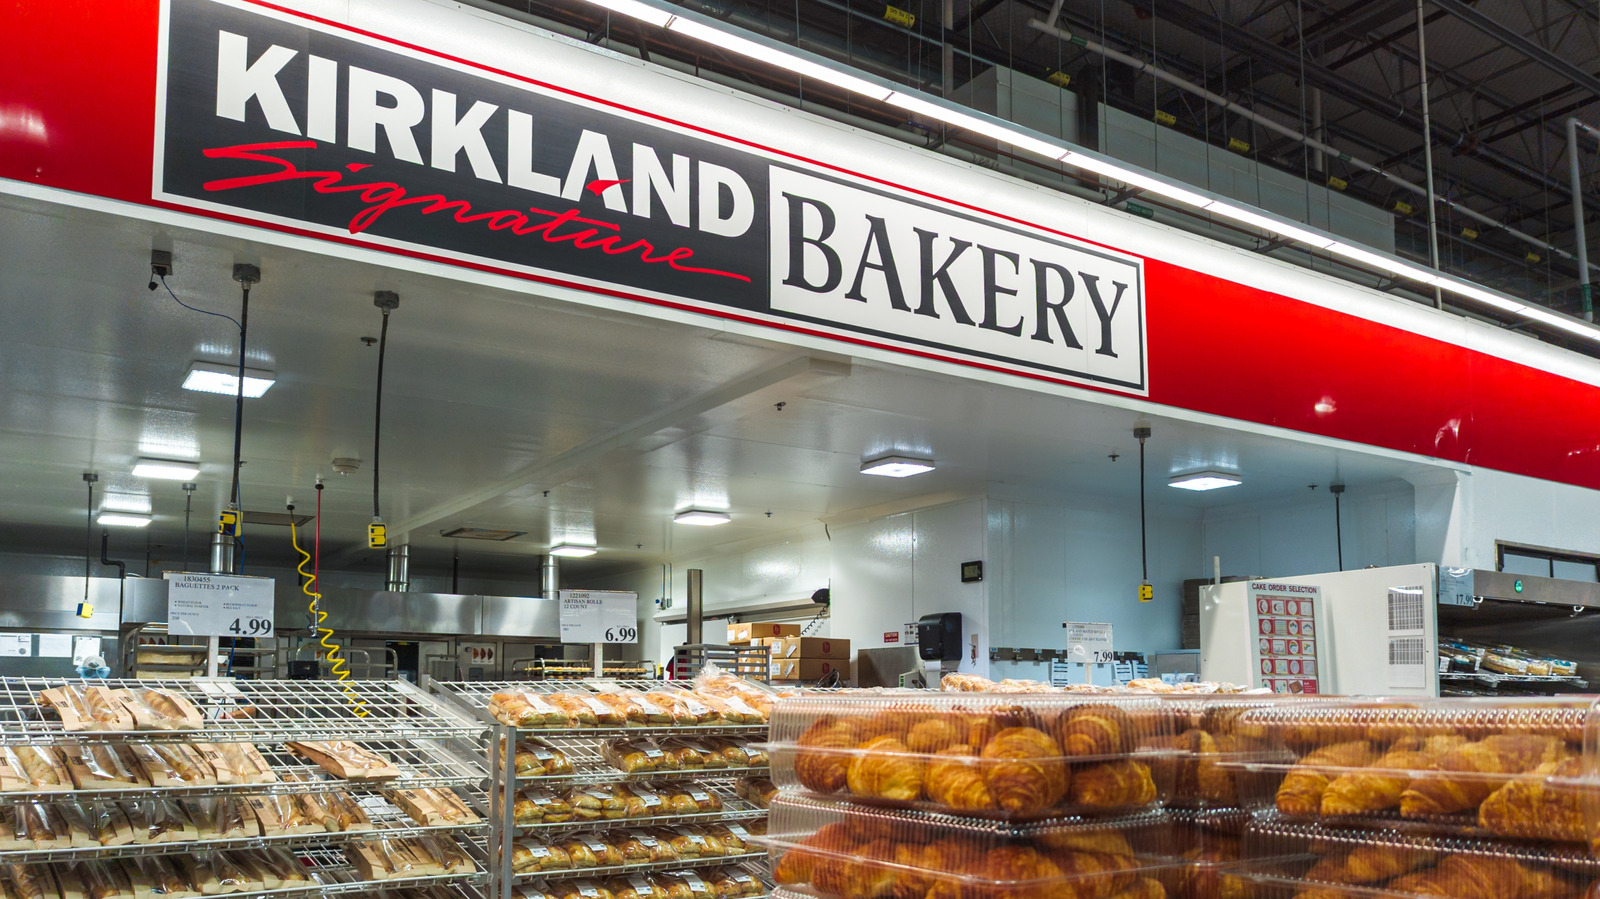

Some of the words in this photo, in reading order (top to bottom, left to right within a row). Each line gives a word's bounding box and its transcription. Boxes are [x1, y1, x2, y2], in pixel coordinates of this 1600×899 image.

[215, 29, 756, 239] KIRKLAND
[202, 140, 752, 284] Signature
[782, 191, 1129, 360] BAKERY
[175, 582, 215, 590] BAGUETTES
[1268, 584, 1287, 592] ORDER
[1289, 585, 1317, 594] SELECTION
[1456, 594, 1473, 605] 17.99
[229, 618, 272, 635] 4.99
[605, 627, 636, 642] 6.99
[1094, 651, 1113, 662] 7.99
